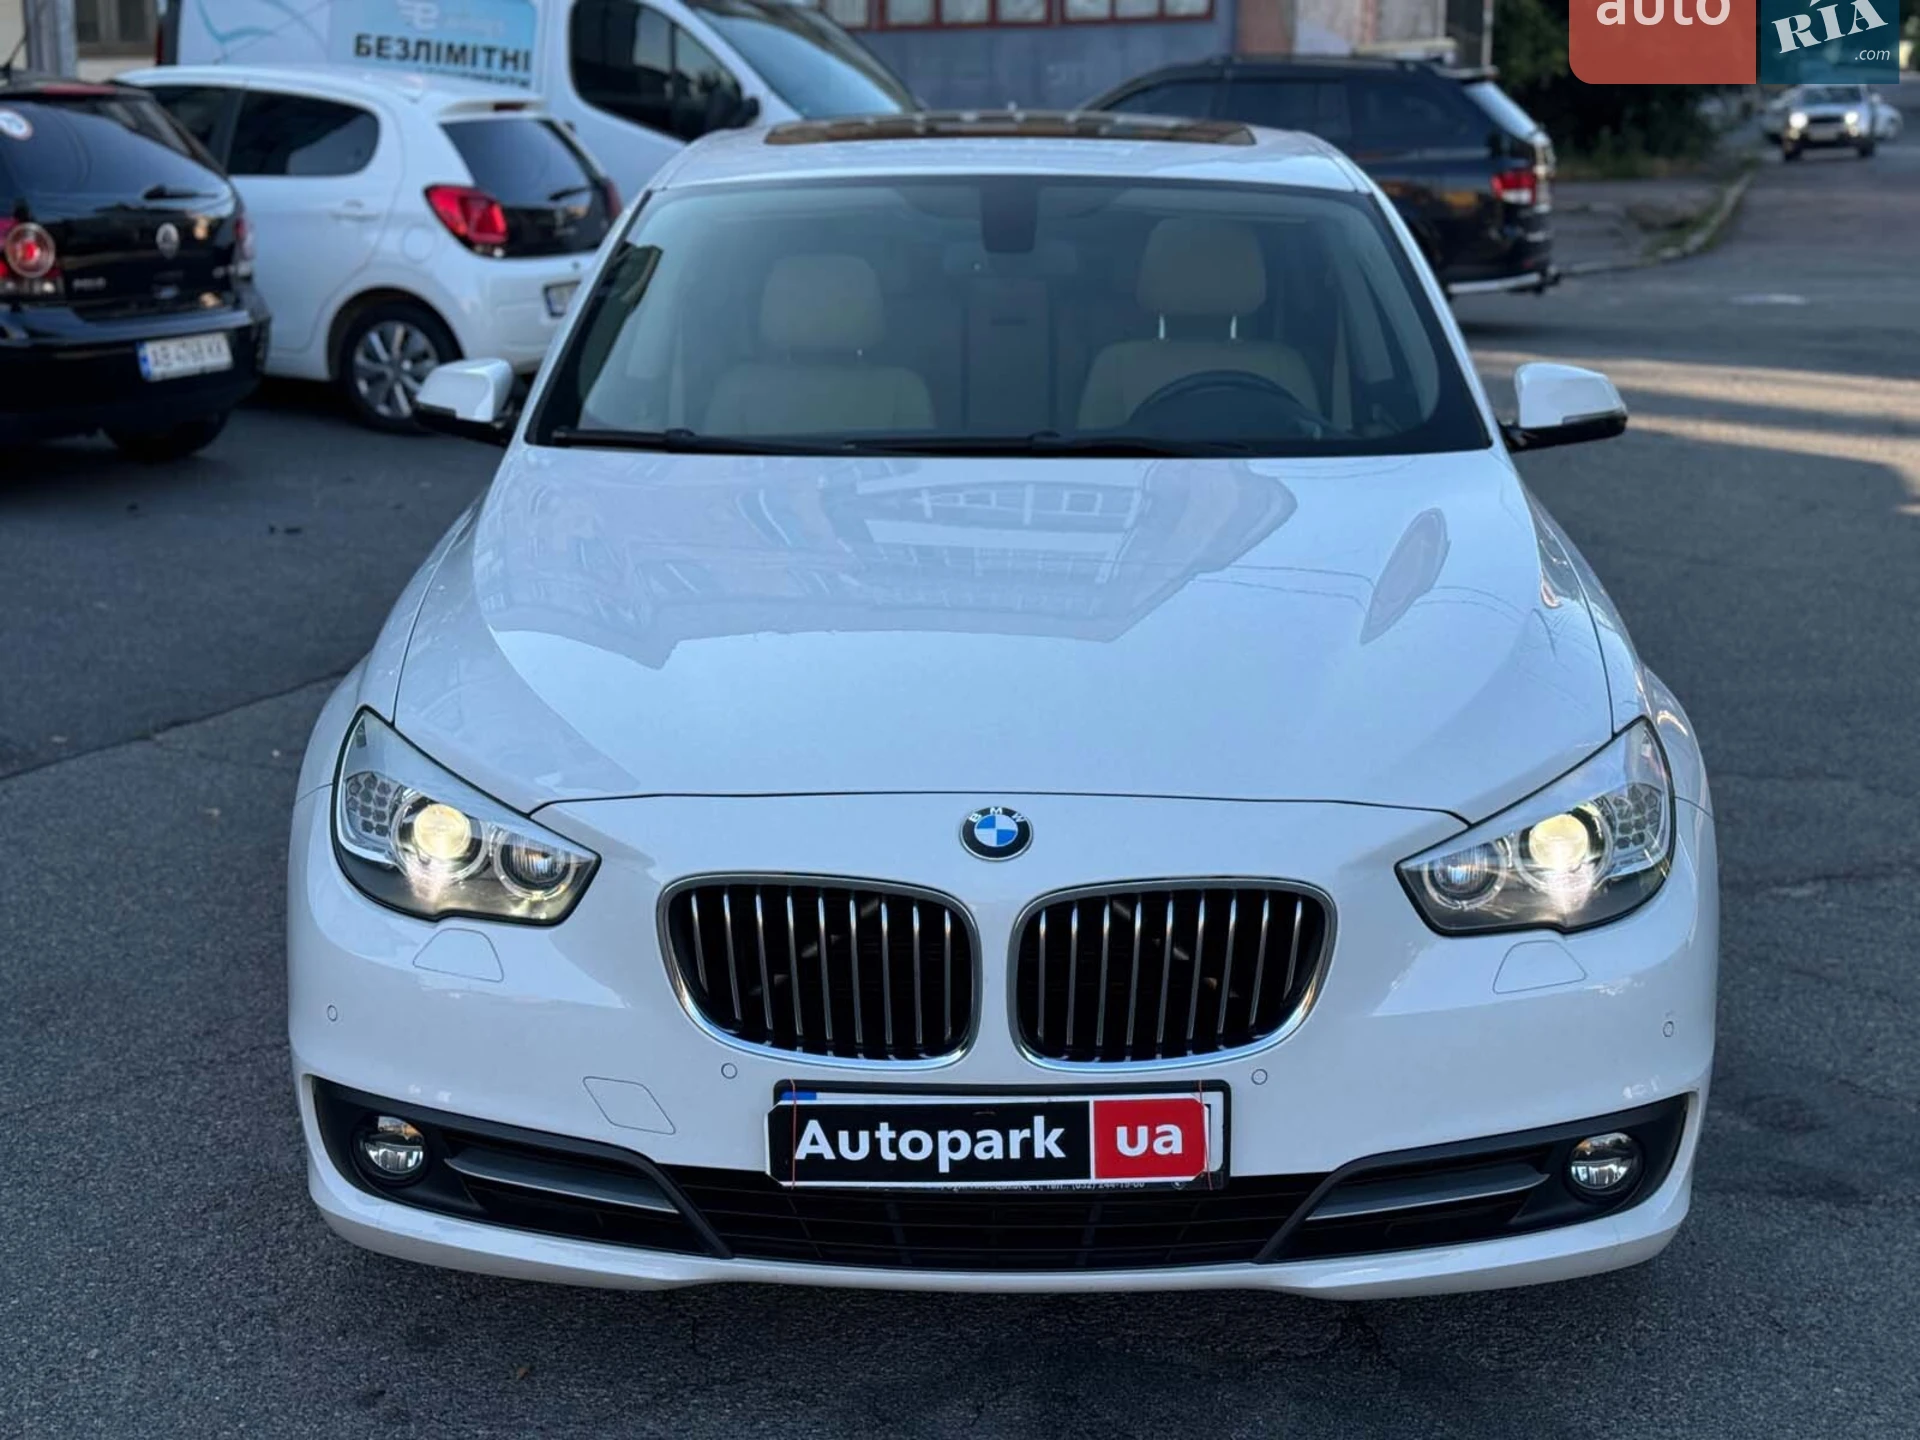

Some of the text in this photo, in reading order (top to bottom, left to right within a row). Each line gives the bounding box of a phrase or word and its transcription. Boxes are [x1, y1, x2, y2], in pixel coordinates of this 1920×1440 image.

[354, 33, 533, 73] БЕЗЛІМІТНІ
[968, 807, 1025, 823] BMW
[795, 1115, 1183, 1173] Autopark ua
